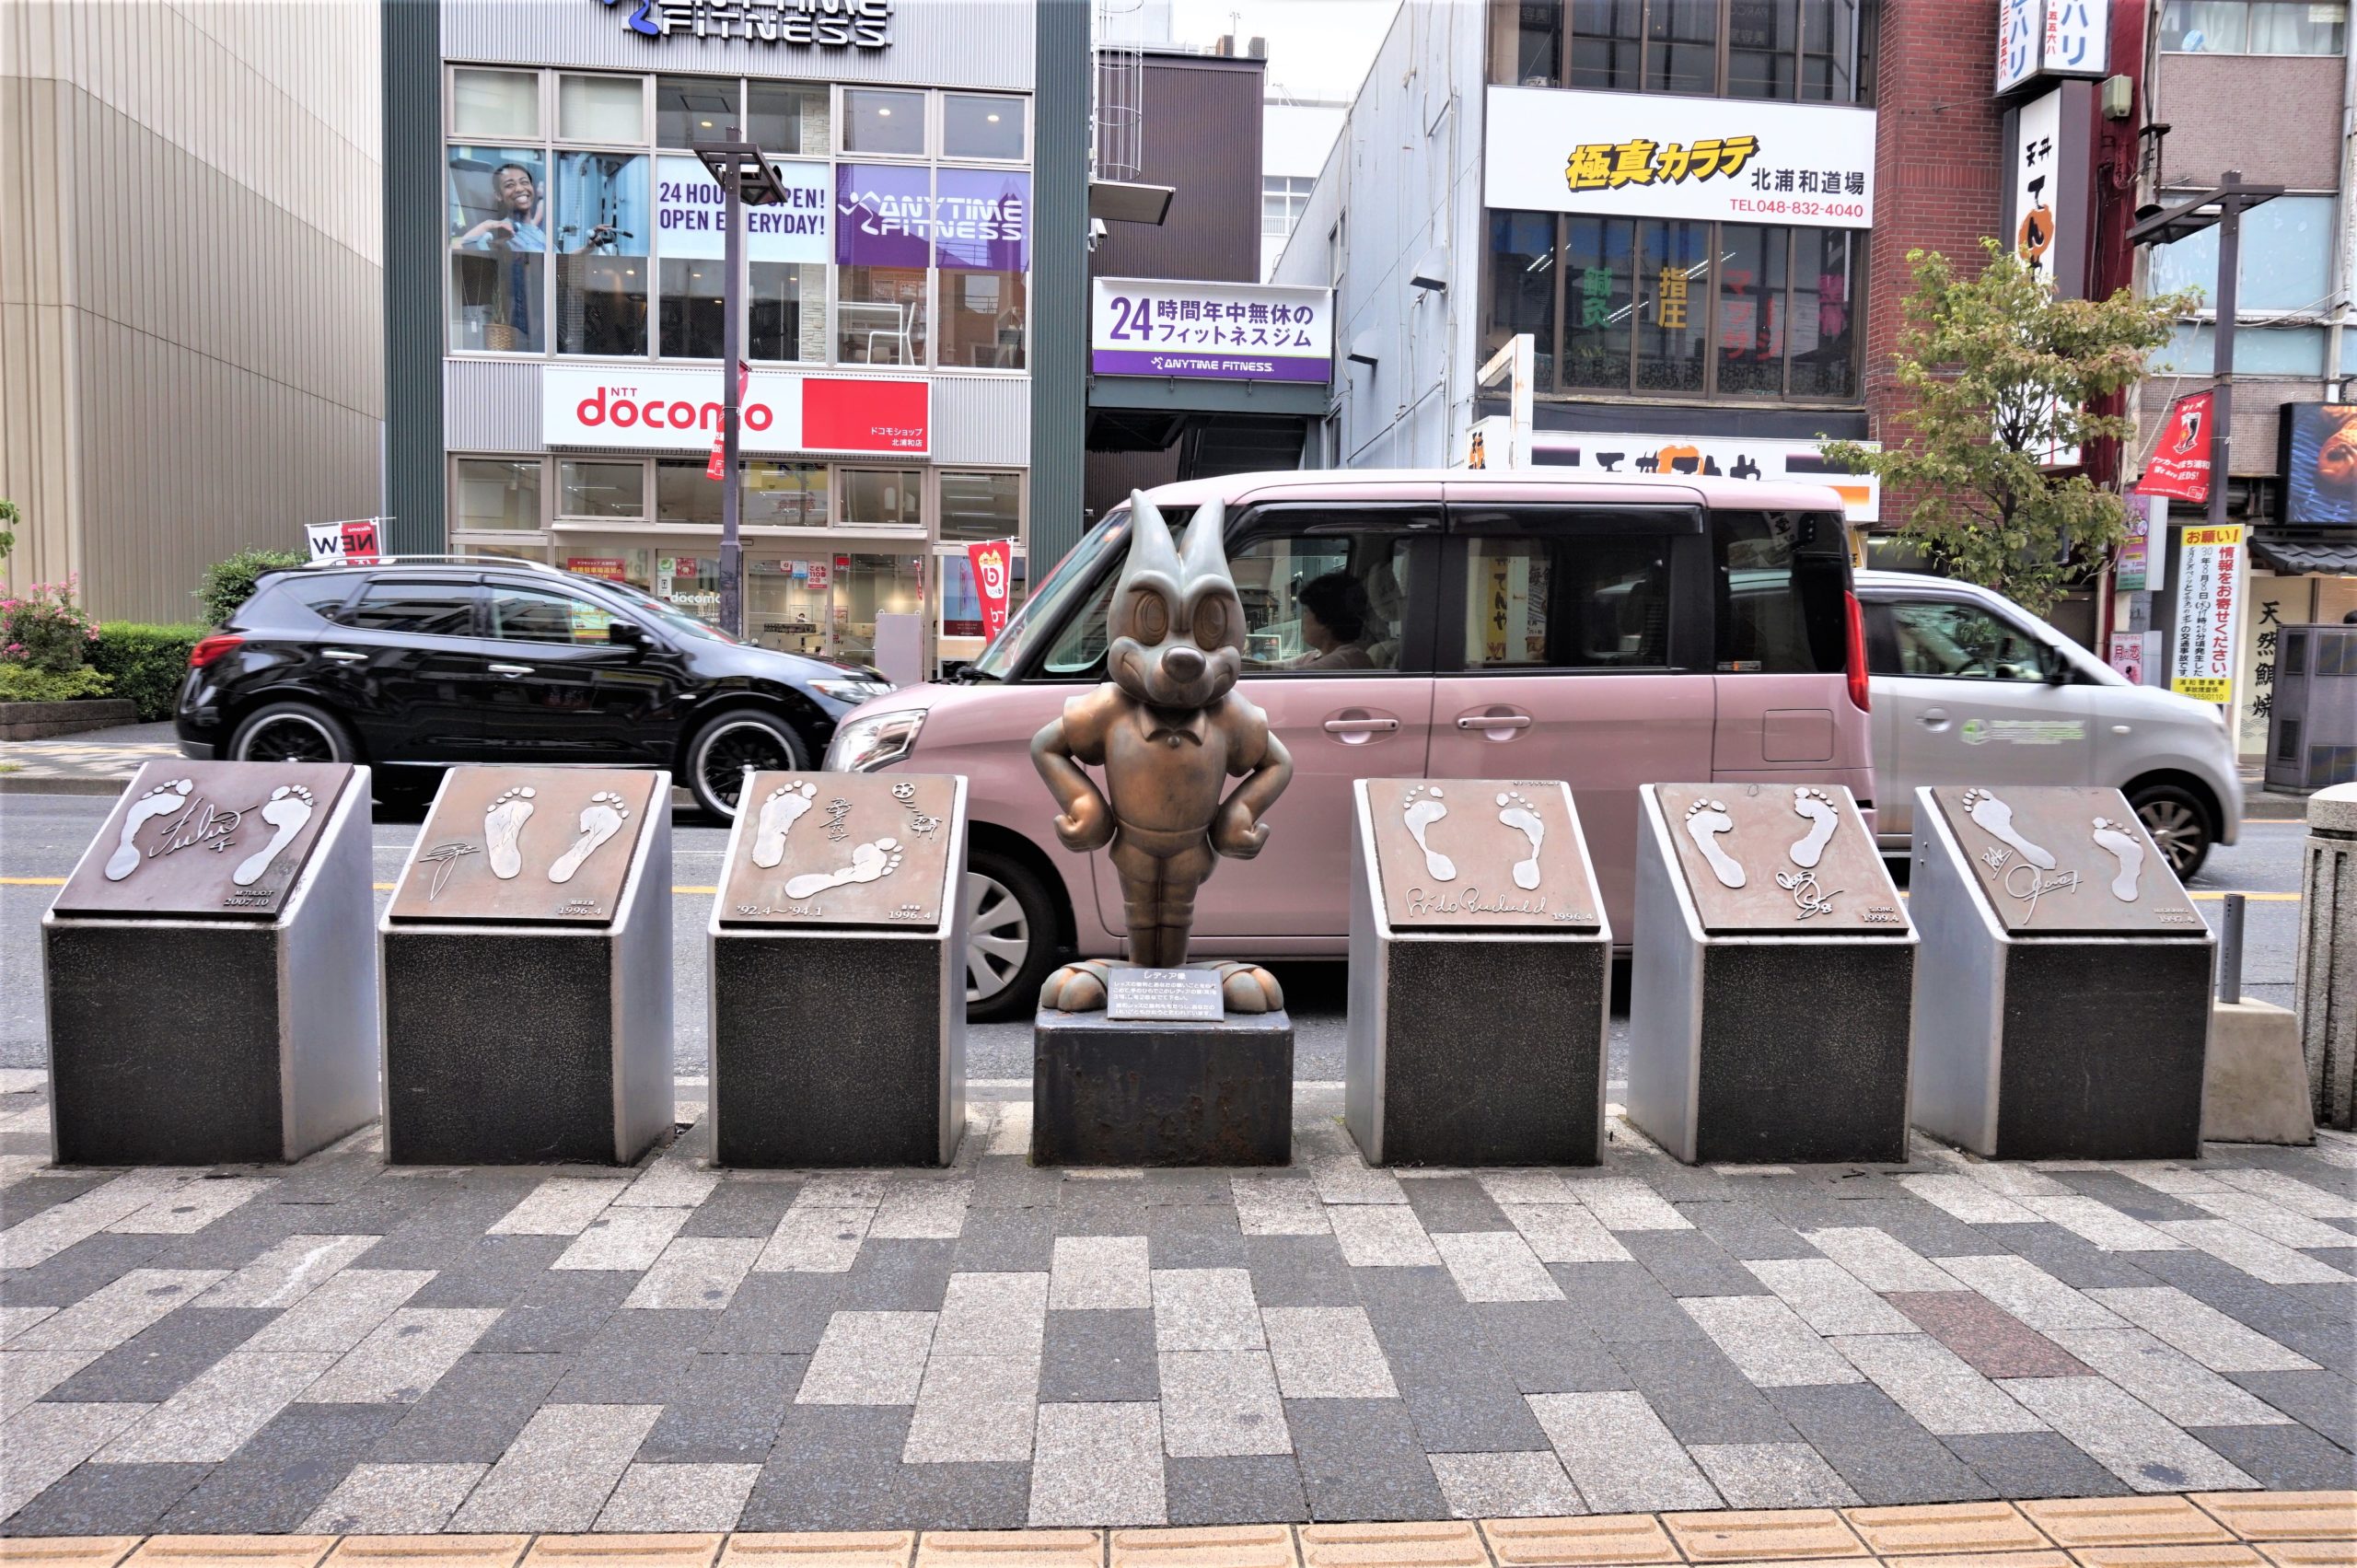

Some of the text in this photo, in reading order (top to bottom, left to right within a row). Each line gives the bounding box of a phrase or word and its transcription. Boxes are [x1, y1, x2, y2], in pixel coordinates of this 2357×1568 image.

[662, 8, 887, 47] FITNESS
[1564, 135, 1760, 192] 極真カラテ
[659, 182, 681, 203] 24
[1751, 168, 1865, 195] 北浦和道場
[877, 193, 1023, 223] ANYTIME
[659, 209, 825, 235] OPEN EERYDAY!
[880, 217, 1023, 241] FITNESS
[1658, 266, 1689, 330] 指圧
[1109, 296, 1154, 341] 24
[1157, 299, 1314, 325] 時間年中無休の
[1157, 323, 1312, 347] フィットネスジム
[1164, 358, 1274, 372] ANYTIME FITNESS
[610, 387, 638, 397] NTT
[870, 426, 923, 437] ドコモショップ
[891, 438, 923, 447] 北浦和店
[223, 899, 270, 907] 2007.10
[558, 907, 603, 915] 1996.4
[888, 911, 932, 920] 1996.4
[1552, 912, 1594, 921] 1996.4
